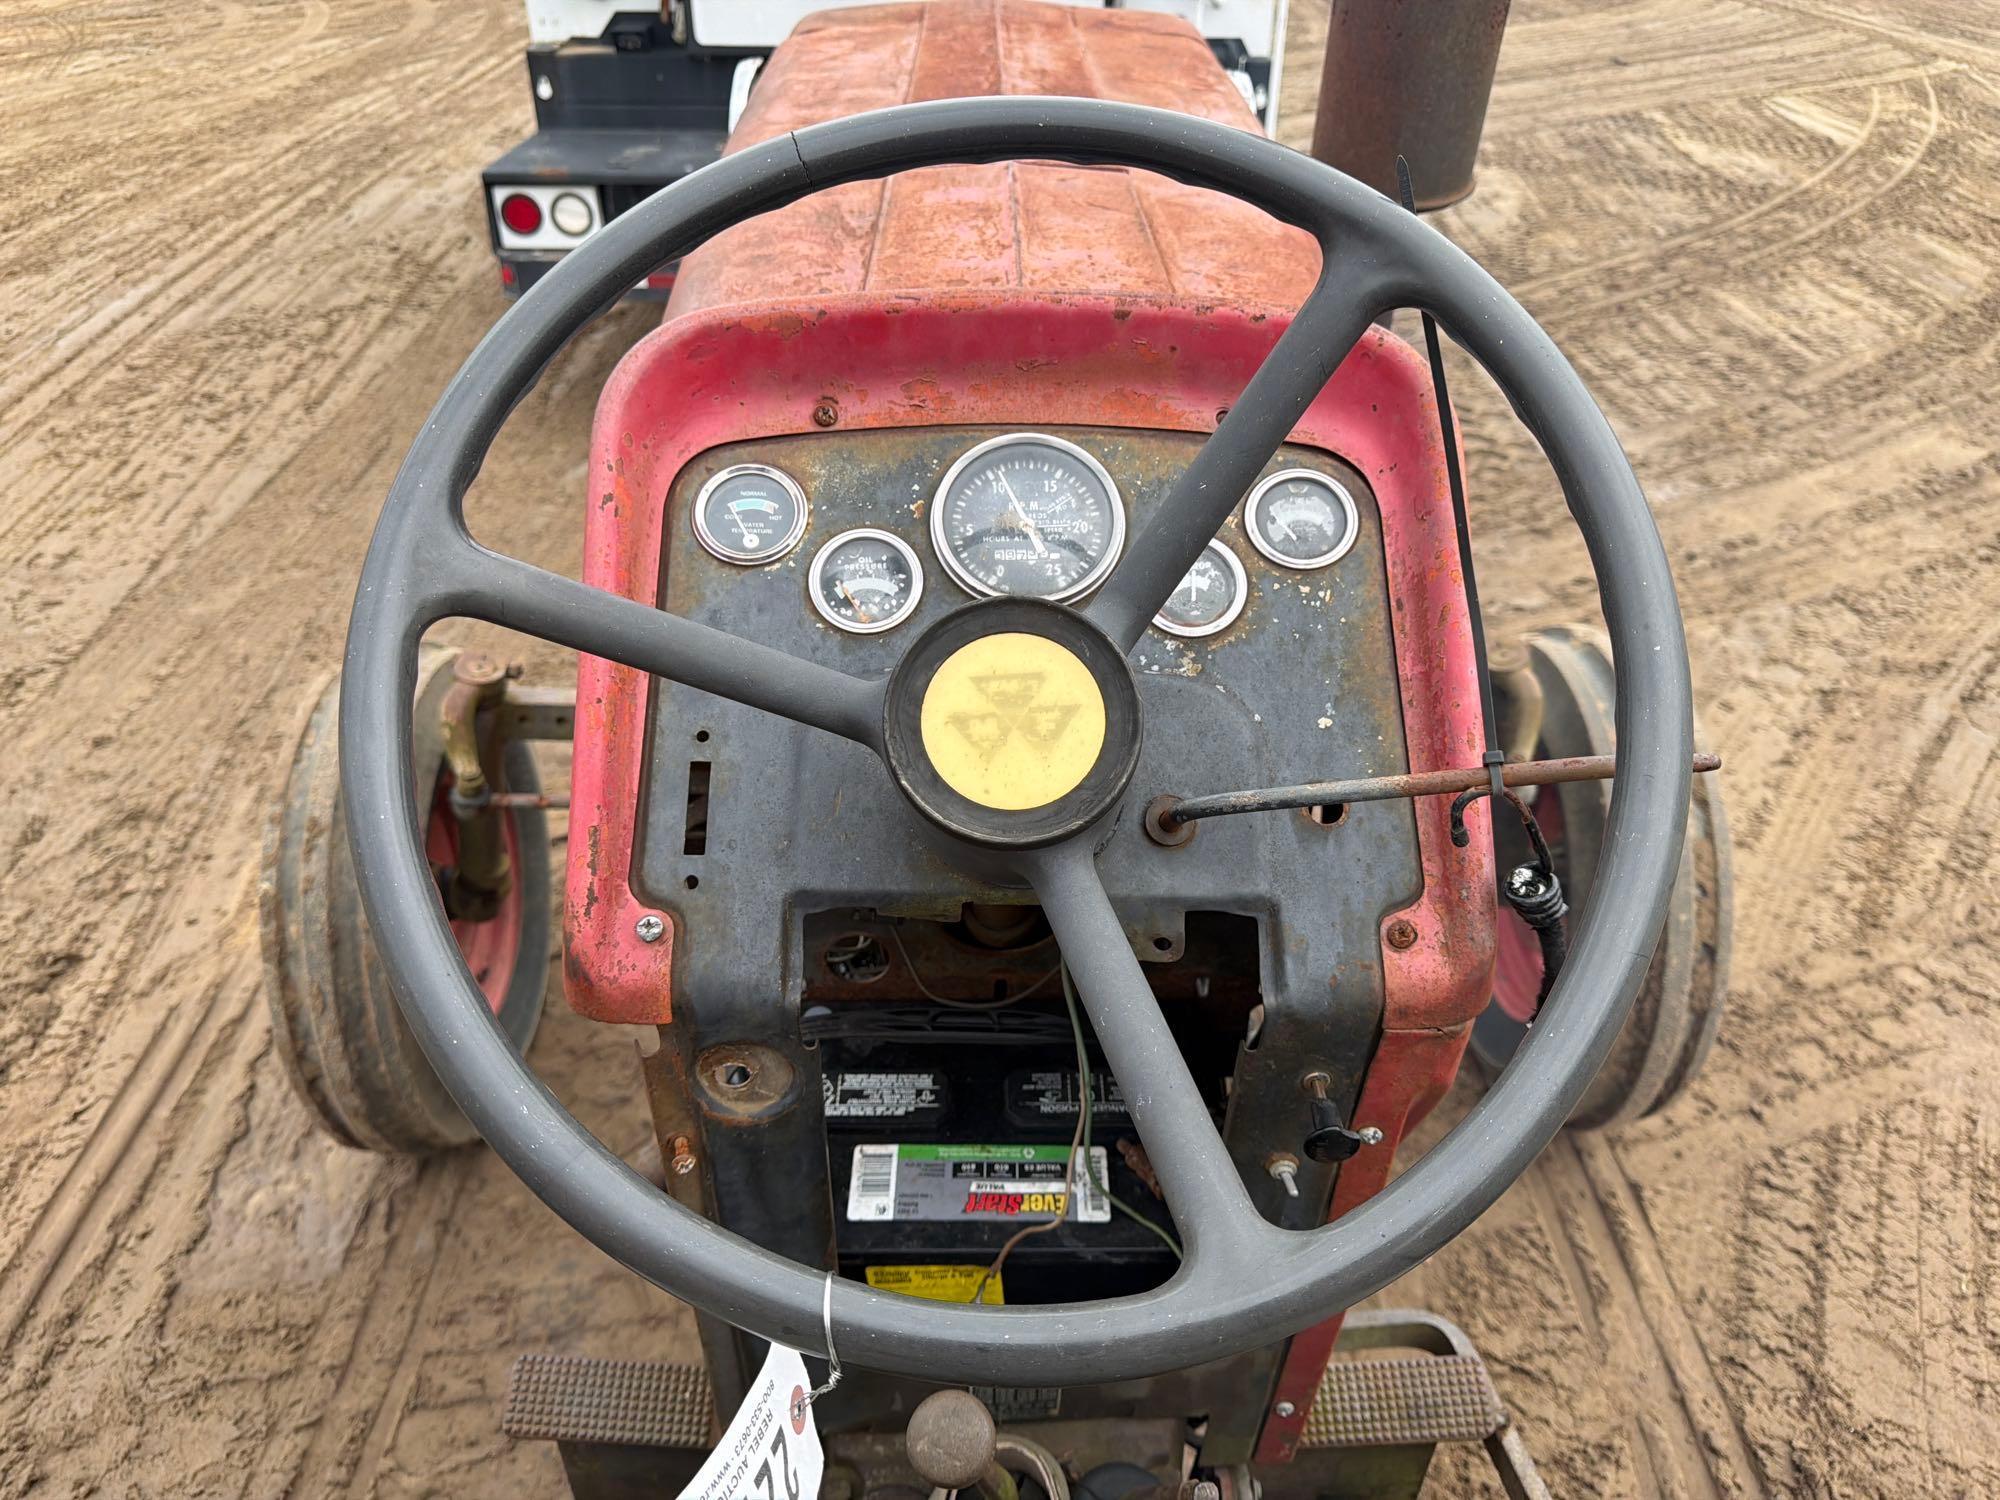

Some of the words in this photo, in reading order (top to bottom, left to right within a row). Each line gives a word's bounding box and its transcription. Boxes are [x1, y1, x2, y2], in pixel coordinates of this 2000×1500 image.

[992, 482, 1005, 494] 10
[1044, 480, 1057, 492] 15
[965, 524, 974, 536] 5
[1072, 521, 1088, 534] 20
[843, 562, 888, 570] PRESSURE
[858, 556, 873, 564] OIL
[996, 564, 1005, 577] 0
[1045, 563, 1062, 576] 25
[965, 1193, 1067, 1215] EverStart
[734, 1379, 775, 1457] 800-533-0673
[748, 1408, 774, 1455] REBEL
